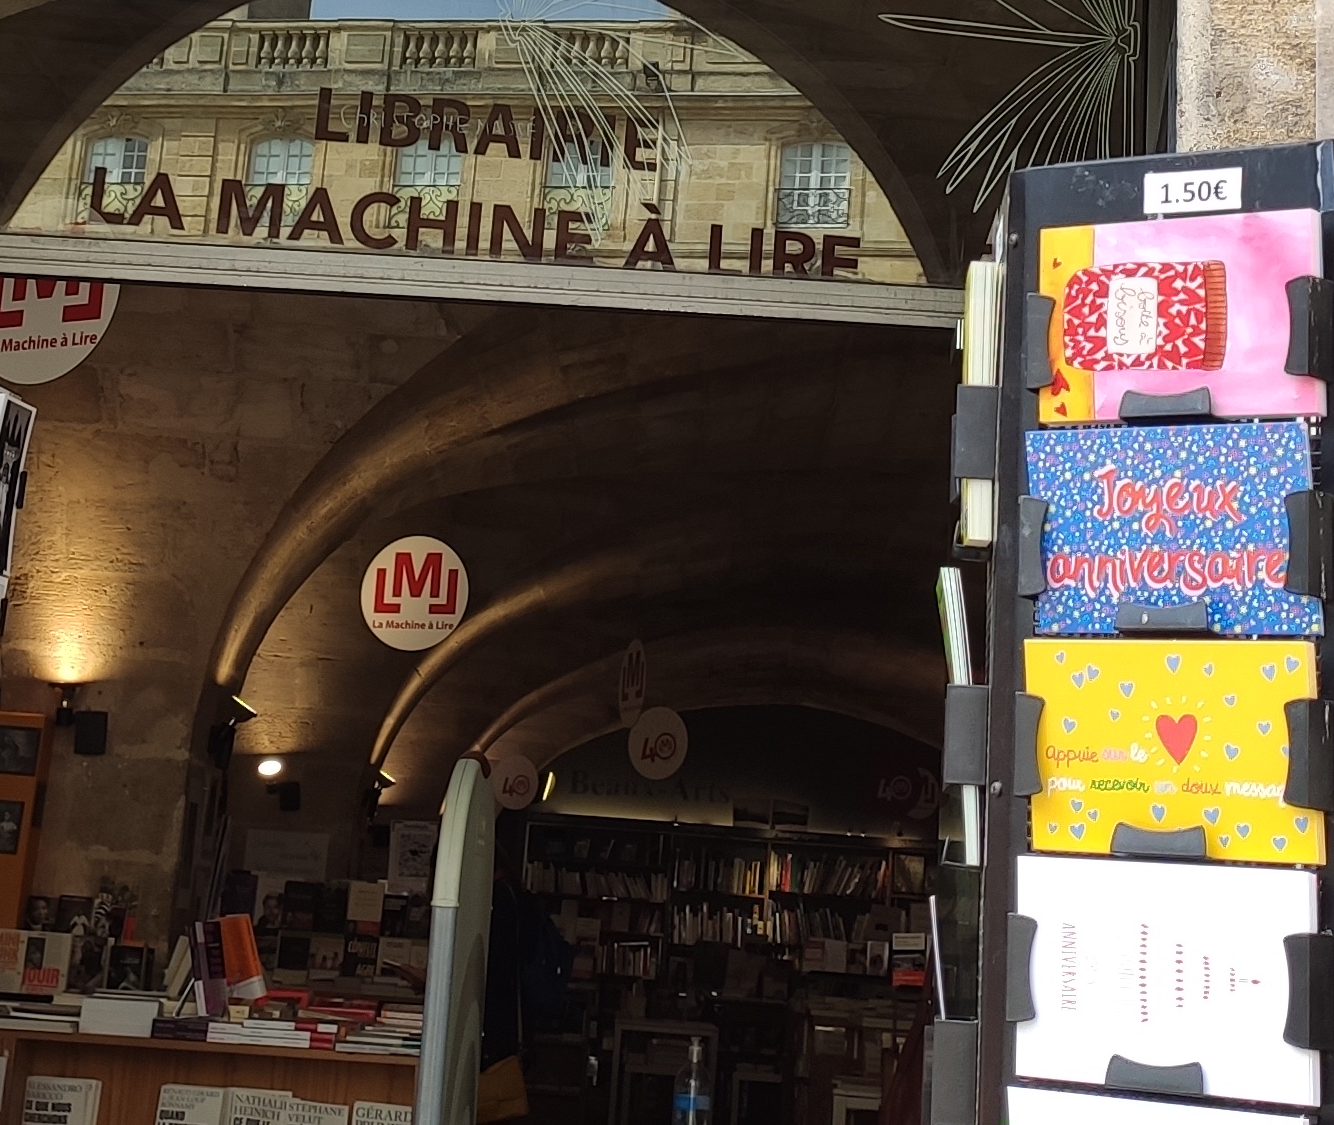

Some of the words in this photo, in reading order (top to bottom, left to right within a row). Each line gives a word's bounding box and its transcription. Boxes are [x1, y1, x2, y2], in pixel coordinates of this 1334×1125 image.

[313, 86, 657, 172] LIBRAIRIE
[1160, 179, 1228, 205] 1.50€
[91, 166, 186, 231] LA
[215, 178, 597, 264] MACHINE
[623, 201, 676, 271] À
[708, 224, 861, 277] LIRE
[0, 335, 57, 352] Machine
[60, 333, 68, 347] à
[71, 331, 98, 346] Lire
[1093, 464, 1247, 538] Joyeux
[1047, 546, 1286, 597] anniversaire
[372, 619, 383, 629] La
[385, 619, 426, 630] Machine
[436, 621, 454, 630] Lire
[1181, 778, 1221, 795] doux
